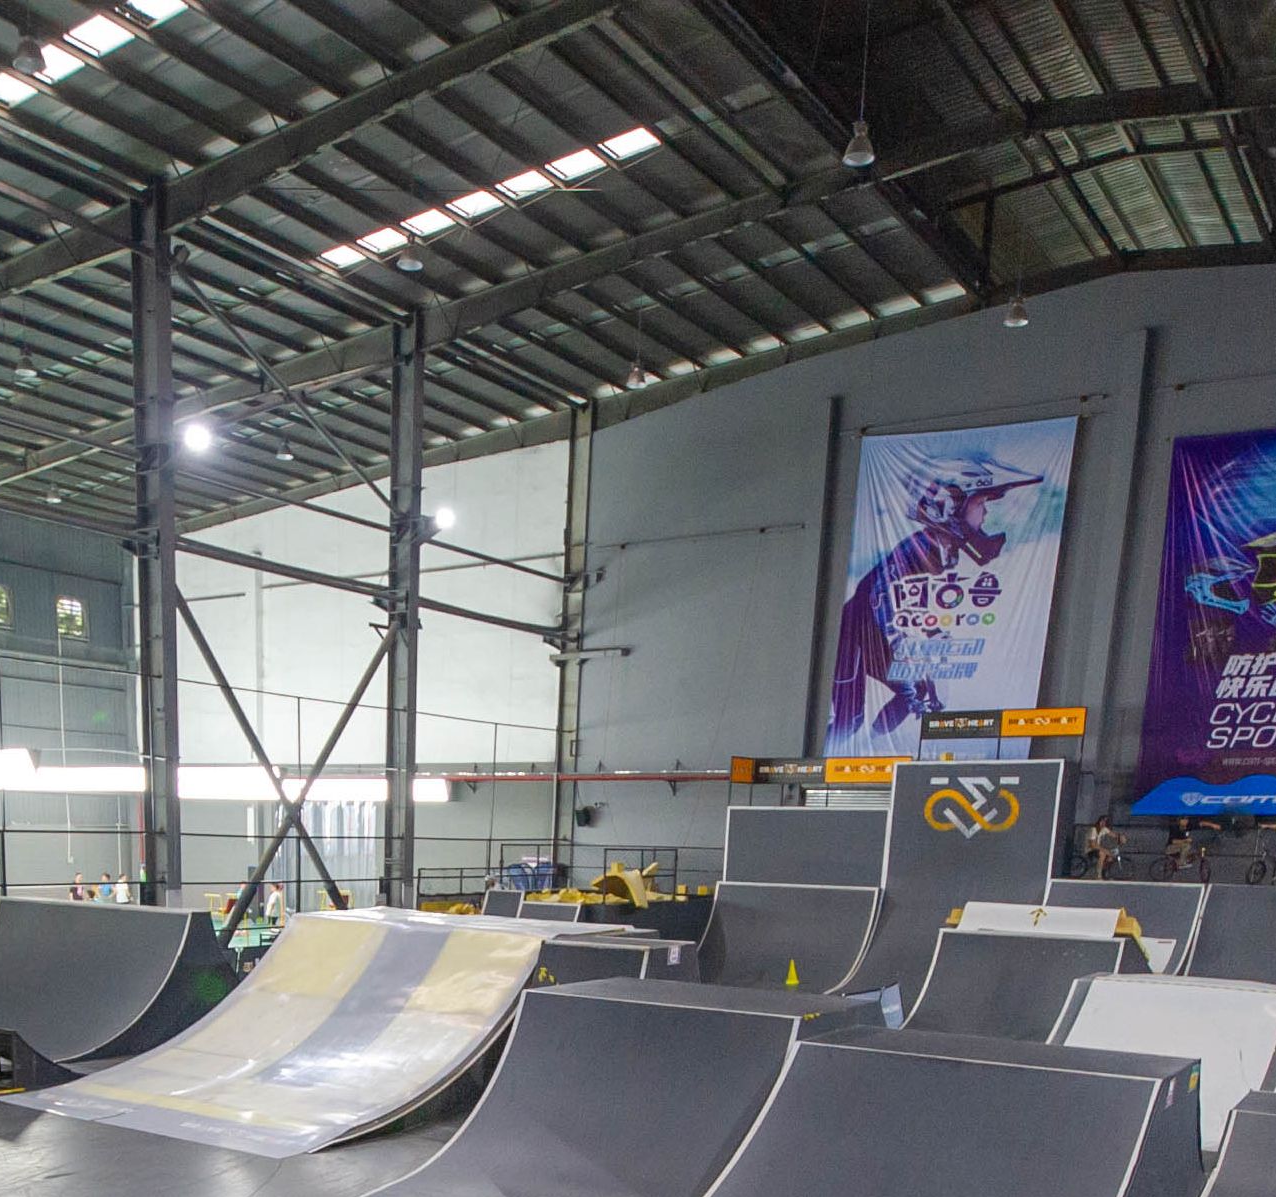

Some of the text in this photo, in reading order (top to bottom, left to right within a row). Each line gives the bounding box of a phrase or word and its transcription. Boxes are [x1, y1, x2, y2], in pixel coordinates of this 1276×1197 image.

[895, 613, 996, 627] acooroo
[929, 718, 995, 729] BRAVE HEART
[759, 766, 784, 774] BRAVE
[797, 765, 823, 774] HEART
[877, 765, 892, 773] HEA
